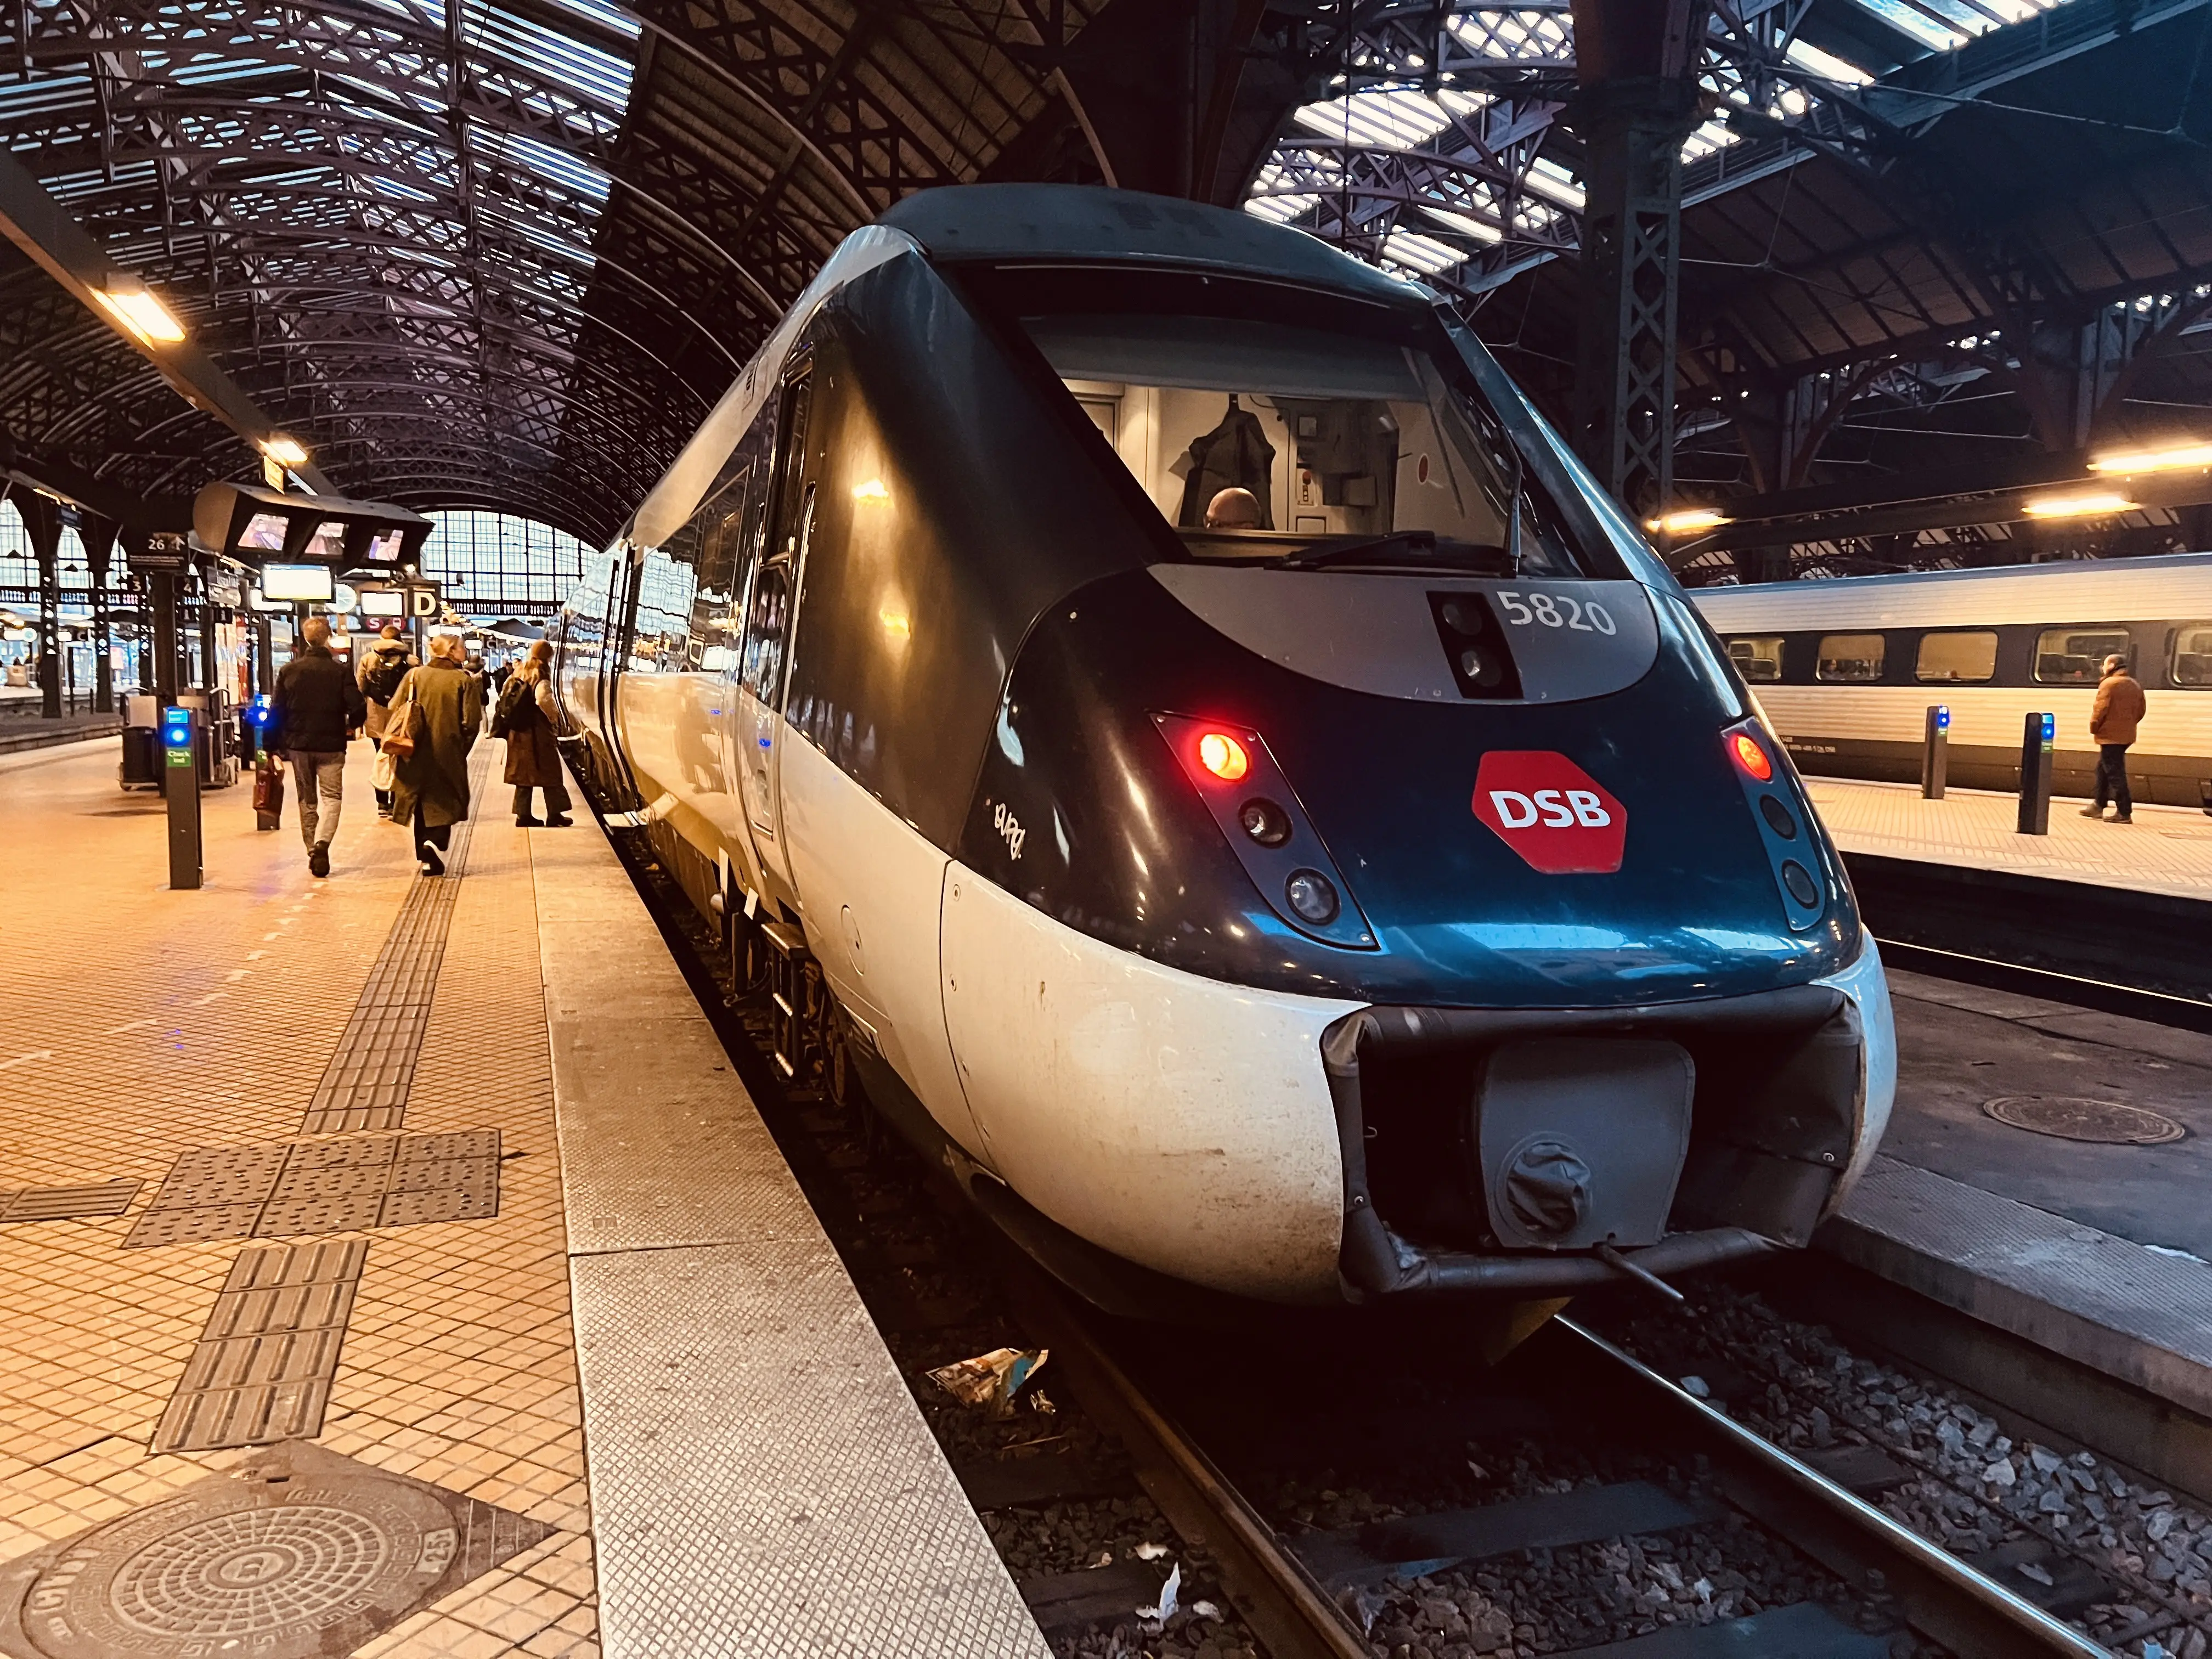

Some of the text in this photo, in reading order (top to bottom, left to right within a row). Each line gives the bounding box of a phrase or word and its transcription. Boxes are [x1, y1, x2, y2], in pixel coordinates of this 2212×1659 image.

[148, 539, 165, 550] 26
[414, 591, 436, 616] D
[1497, 591, 1616, 635] 5820
[369, 618, 380, 629] S
[1489, 789, 1611, 828] DSB
